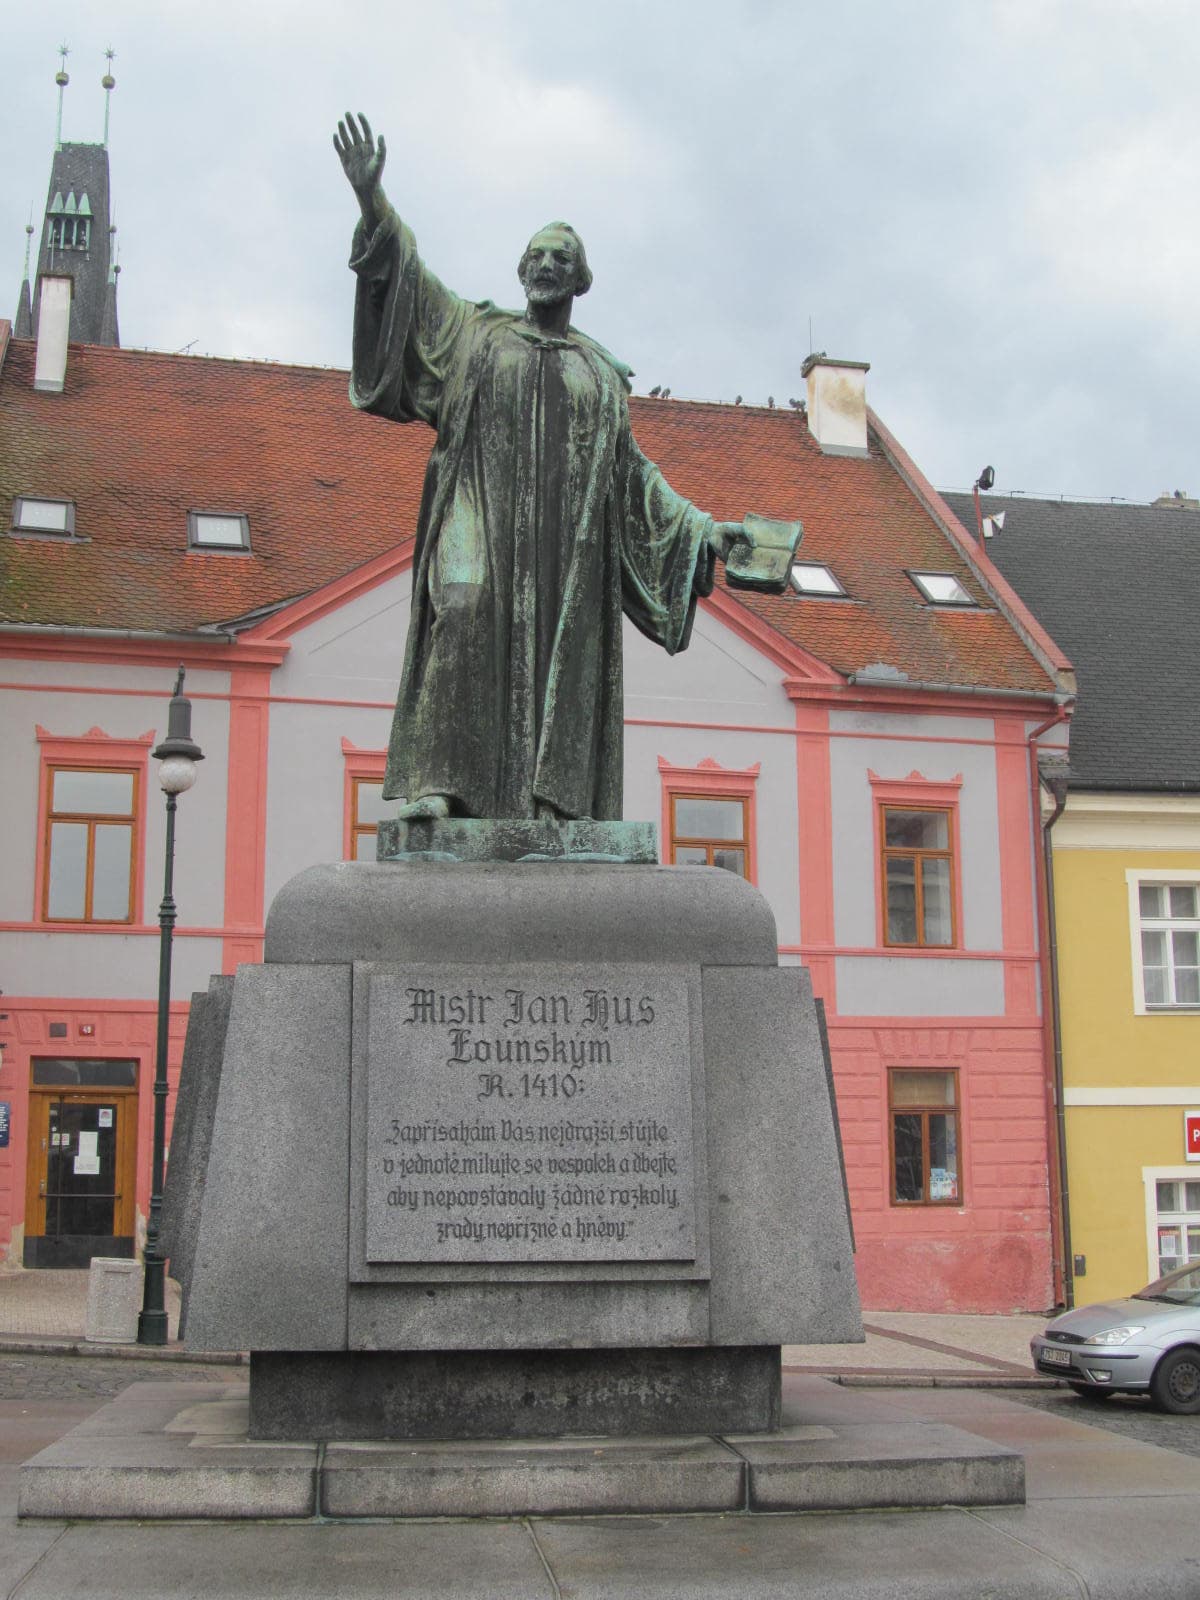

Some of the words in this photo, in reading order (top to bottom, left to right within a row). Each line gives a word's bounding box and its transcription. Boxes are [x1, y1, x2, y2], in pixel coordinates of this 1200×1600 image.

[403, 988, 494, 1025] Mistr
[503, 989, 570, 1027] Jan
[581, 989, 656, 1031] Hus
[447, 1029, 612, 1069] Lounským
[477, 1074, 513, 1101] R.
[383, 1158, 394, 1174] v
[463, 1152, 521, 1178] milujte
[524, 1157, 543, 1174] se
[548, 1153, 616, 1177] vespolek
[619, 1157, 630, 1174] a
[387, 1185, 418, 1211] aby
[423, 1184, 546, 1210] nepovstávaly
[552, 1184, 605, 1209] žádné
[609, 1184, 681, 1209] rozkoly,
[562, 1223, 572, 1239] a
